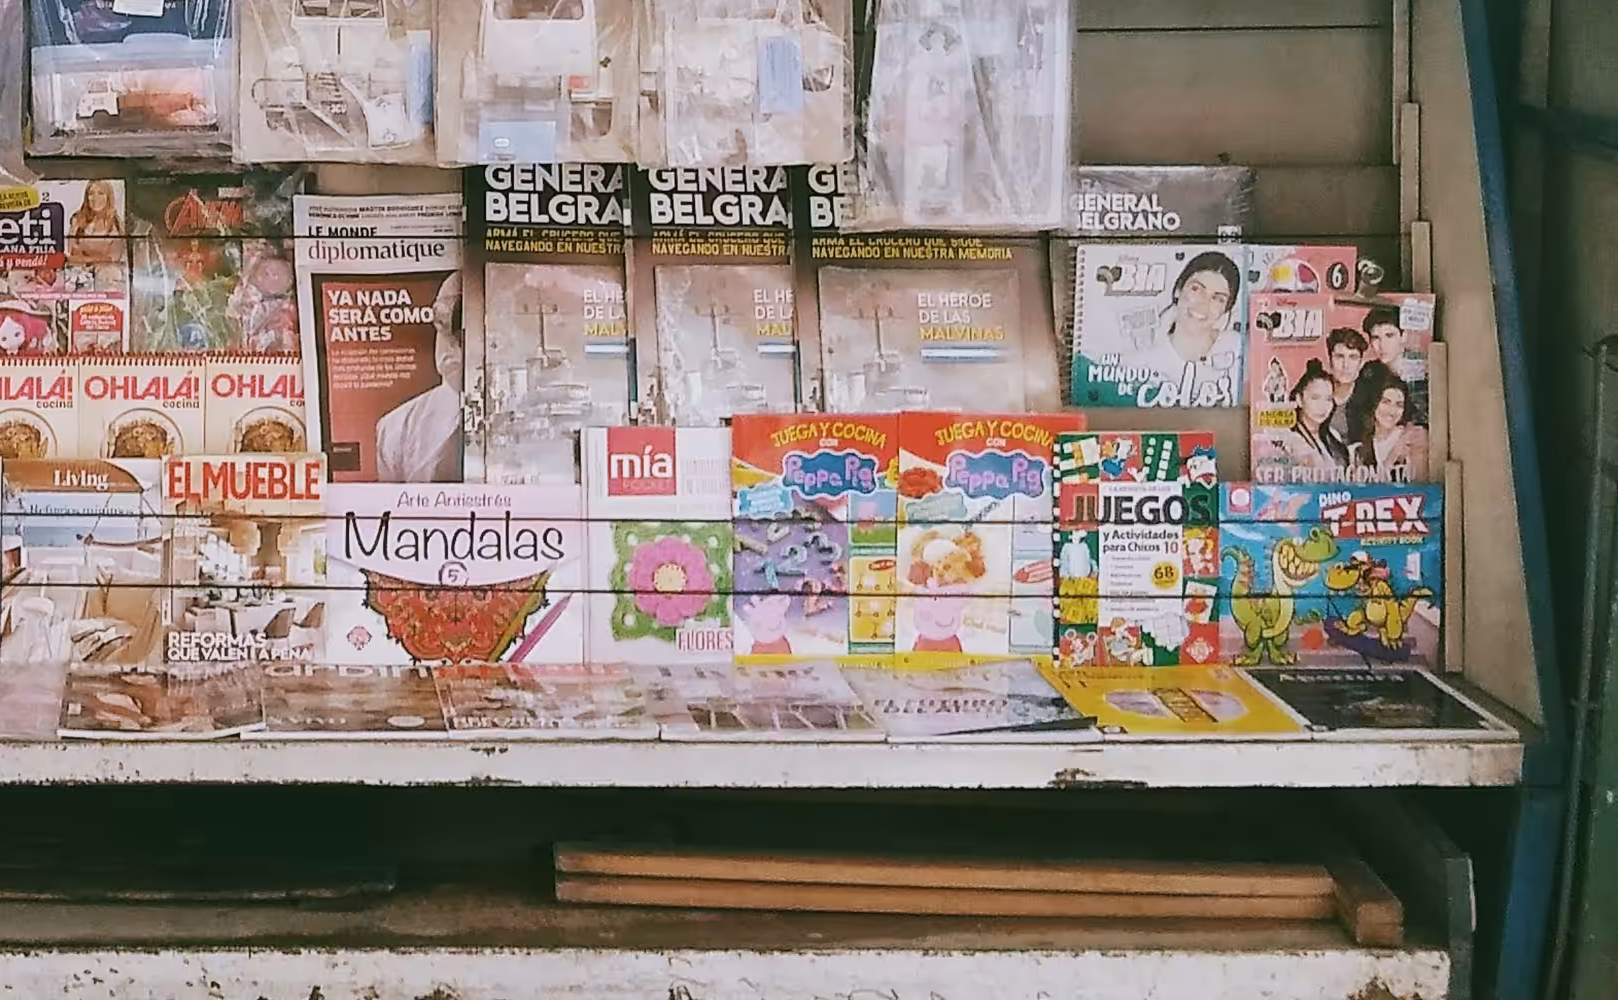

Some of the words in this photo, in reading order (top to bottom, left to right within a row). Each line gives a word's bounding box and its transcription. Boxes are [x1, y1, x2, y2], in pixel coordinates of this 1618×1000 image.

[328, 226, 377, 237] MONDE
[308, 240, 445, 264] diplomatique
[485, 240, 553, 253] NAVEGANDO
[556, 240, 572, 252] EN
[652, 244, 718, 256] NAVEGANDO
[721, 244, 739, 256] EN
[812, 247, 881, 259] NAVEGANDO
[884, 247, 900, 259] EN
[902, 247, 955, 259] NUESTRA
[958, 248, 1012, 259] MEMORIA
[1331, 266, 1344, 288] 6
[328, 290, 357, 305] YA
[362, 289, 412, 306] NADA
[584, 290, 601, 302] EL
[754, 289, 772, 303] EL
[918, 293, 936, 307] EL
[329, 304, 376, 325] SERÁ
[380, 306, 433, 323] COMO
[584, 306, 604, 320] DE
[755, 306, 775, 319] DE
[919, 310, 939, 323] DE
[942, 310, 970, 324] LAS
[330, 326, 392, 342] ANTES
[919, 325, 1003, 340] MALVINAS
[84, 369, 200, 401] OHLALÁ!
[36, 400, 73, 410] cocina
[162, 399, 199, 409] cocina
[770, 427, 819, 448] JUEGA
[819, 422, 831, 440] Y
[831, 422, 887, 449] COCINA
[934, 427, 983, 447] JUEGA
[984, 422, 997, 440] Y
[820, 439, 838, 447] CON
[986, 439, 1005, 447] CON
[610, 445, 673, 480] mía
[53, 470, 109, 490] Living
[167, 461, 198, 499] EL
[202, 462, 320, 500] MUEBLE
[785, 457, 842, 492] Peppa
[845, 458, 875, 493] Pig
[949, 457, 1008, 492] Peppa
[1012, 458, 1042, 493] Pig
[397, 491, 430, 508] Arte
[1318, 493, 1351, 507] DINO
[1071, 493, 1211, 526] JUEGOS
[1324, 496, 1429, 537] T-REX
[344, 511, 564, 562] Mandalas
[1112, 530, 1178, 540] Actividades
[1103, 543, 1126, 553] para
[1128, 542, 1160, 552] Chicos
[1165, 542, 1178, 553] 10
[167, 632, 267, 649] REFORMAS
[167, 647, 198, 661] QUE
[200, 647, 245, 661] VALEN
